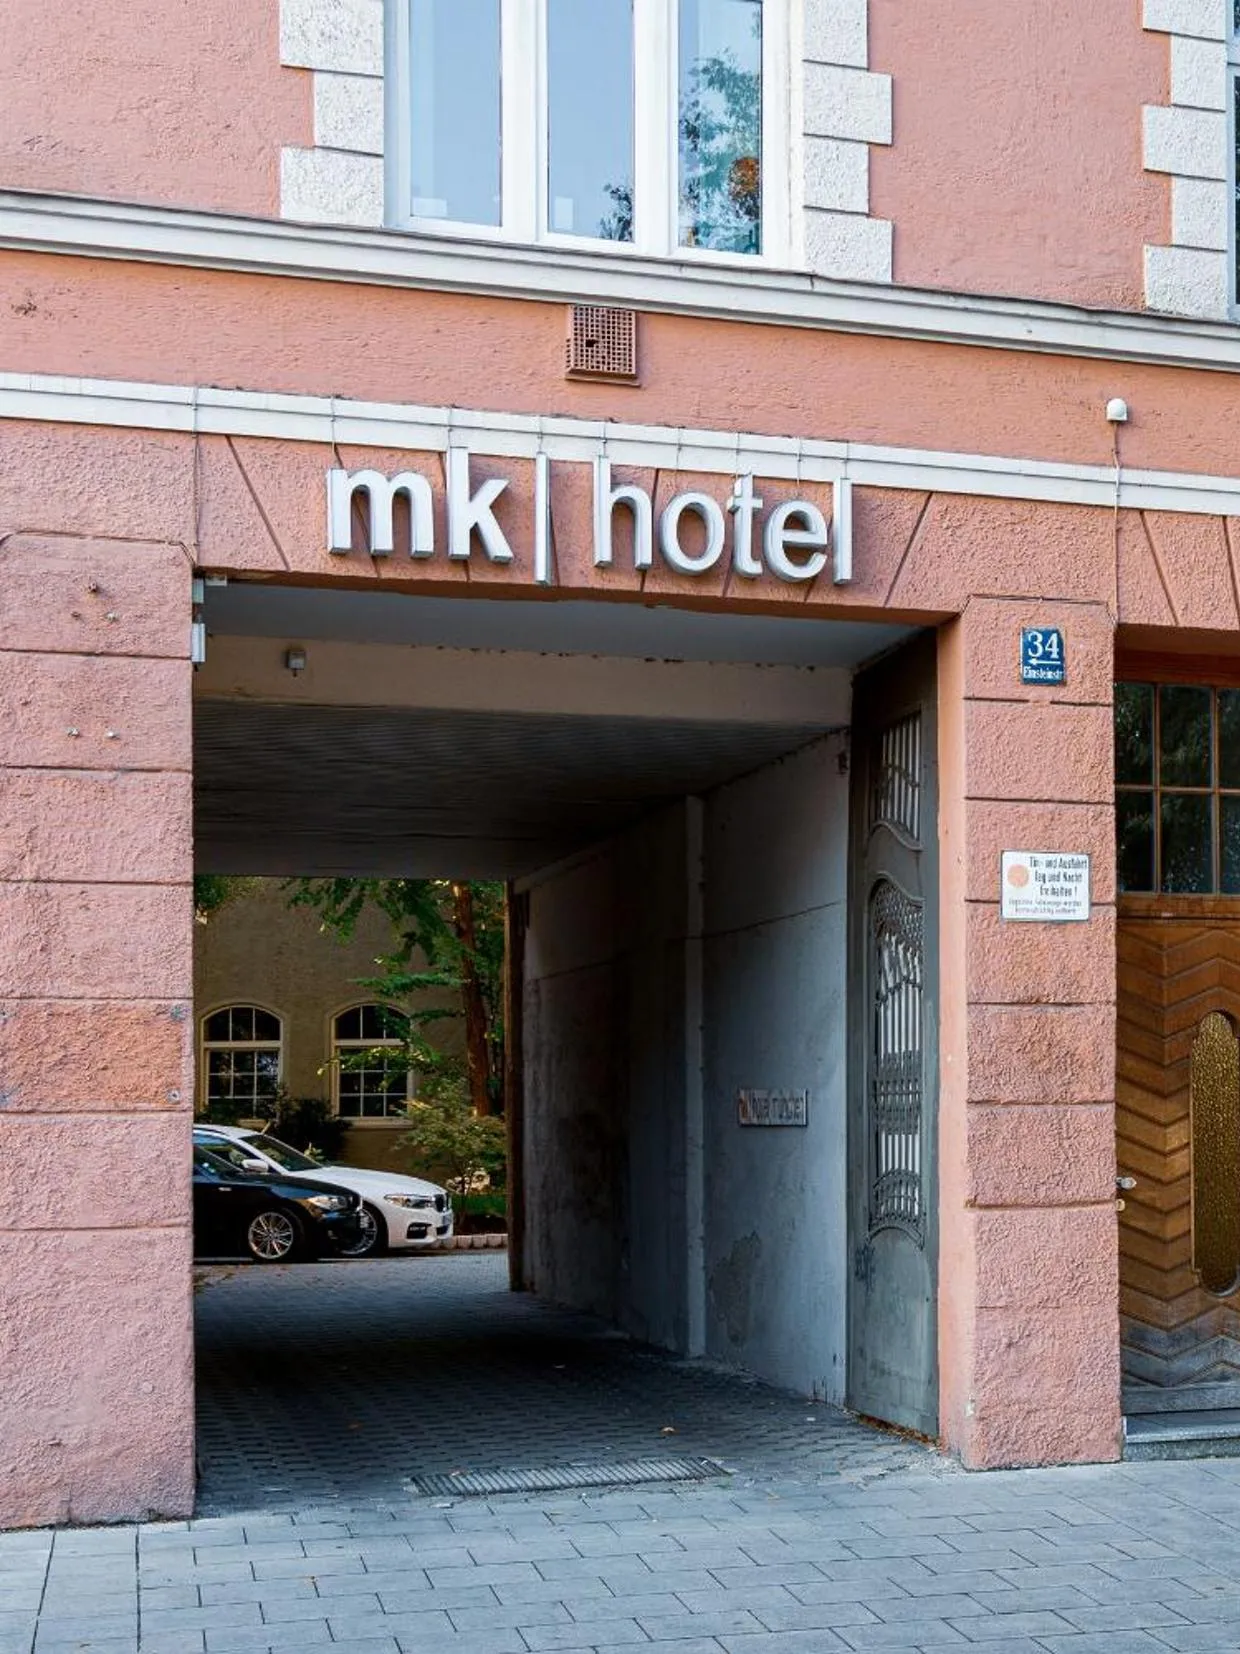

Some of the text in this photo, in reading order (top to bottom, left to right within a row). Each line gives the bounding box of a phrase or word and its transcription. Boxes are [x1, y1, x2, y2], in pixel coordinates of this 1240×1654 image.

[328, 447, 512, 564] mk
[593, 455, 853, 585] hotel
[1027, 631, 1060, 658] 34
